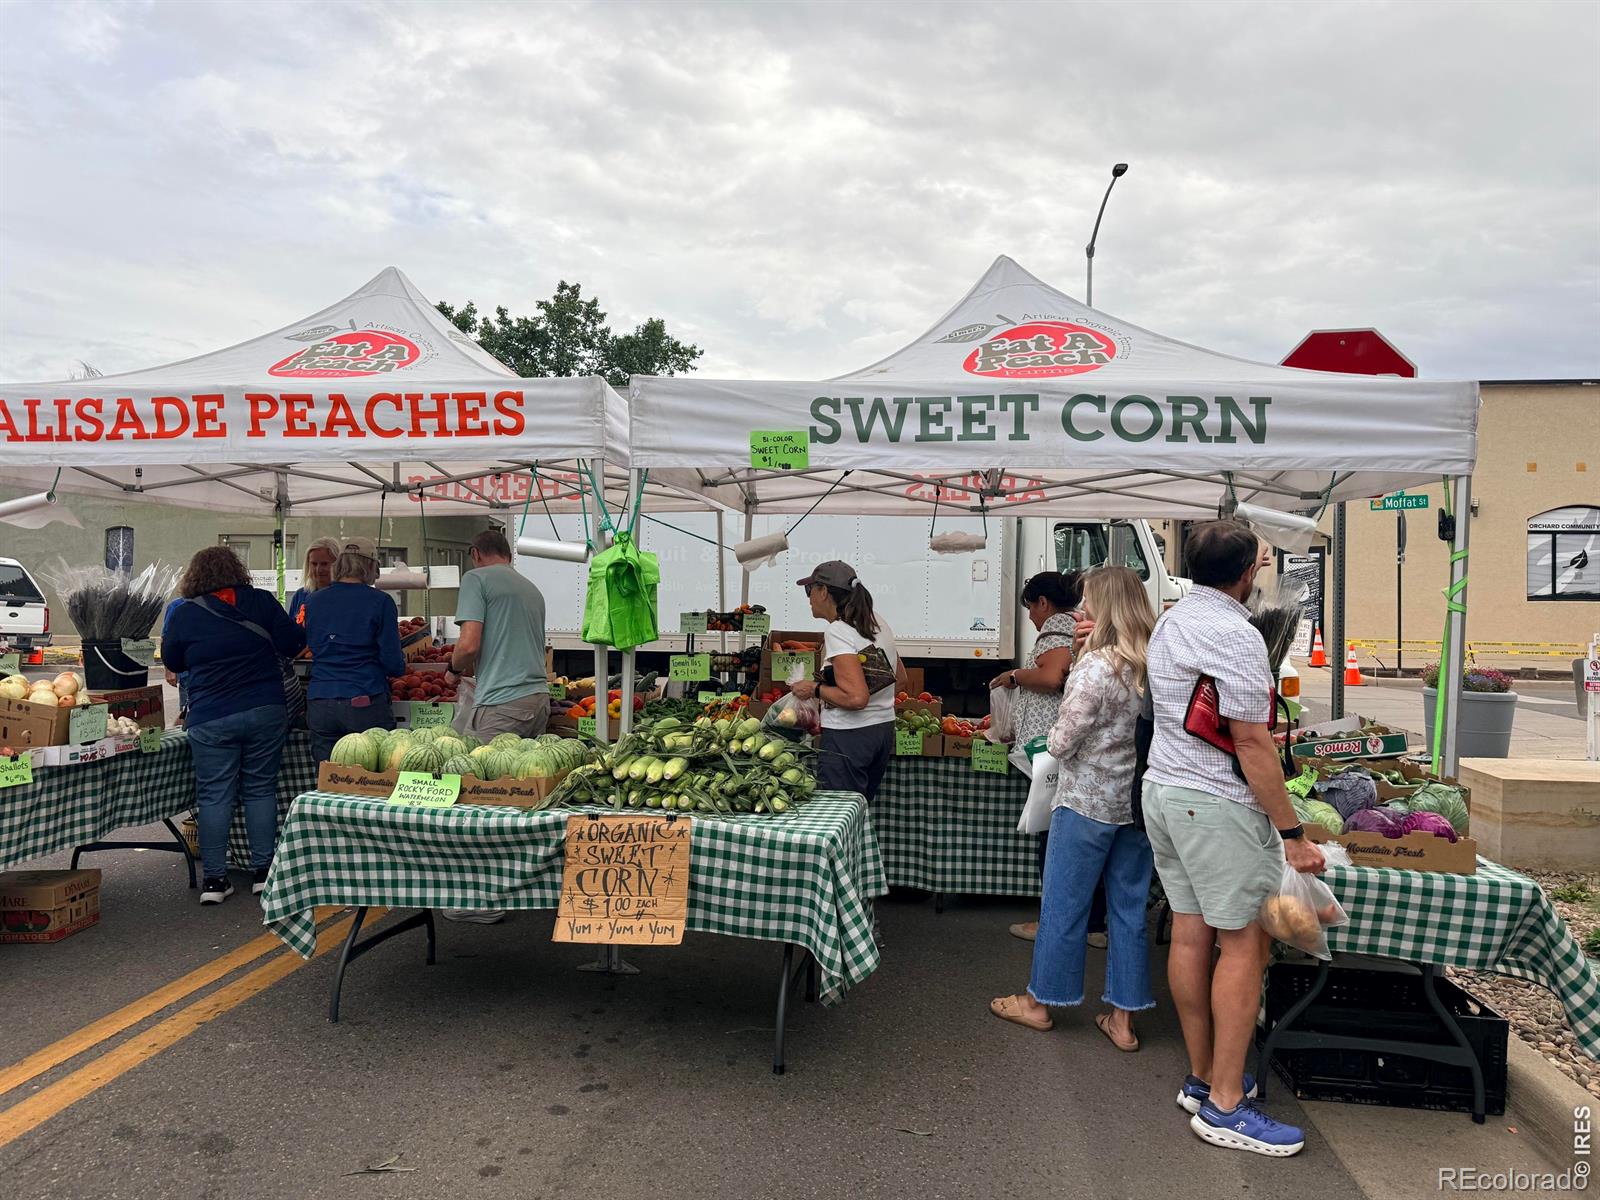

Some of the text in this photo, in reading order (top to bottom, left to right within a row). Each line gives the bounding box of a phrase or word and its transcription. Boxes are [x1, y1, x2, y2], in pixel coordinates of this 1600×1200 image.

[1022, 313, 1070, 322] Artisan
[364, 321, 407, 335] Artisan
[303, 341, 408, 360] Eat A
[978, 332, 1106, 359] Eat A
[276, 357, 397, 373] Peach
[975, 349, 1111, 373] Peach
[244, 390, 526, 440] PEACHES
[809, 393, 1273, 445] SWEET CORN
[762, 435, 795, 443] BI-COLOR
[751, 443, 806, 455] SWEET CORN
[1385, 497, 1427, 508] Moffat St
[415, 716, 446, 725] PEACHES
[975, 743, 1007, 756] Heirloom
[1315, 740, 1362, 757] Remo's
[0, 762, 29, 773] Shallots
[327, 772, 395, 787] Rocky Mountain
[411, 779, 438, 787] SMALL
[397, 783, 454, 797] ROCKY FORD
[468, 784, 536, 797] Mountain Fresh
[398, 793, 447, 803] WATERMELON
[587, 820, 675, 844] ORGANIC
[583, 844, 665, 869] SWEET
[1345, 841, 1426, 858] Mountain Fresh
[575, 866, 659, 898] CORN
[636, 897, 659, 909] EACH
